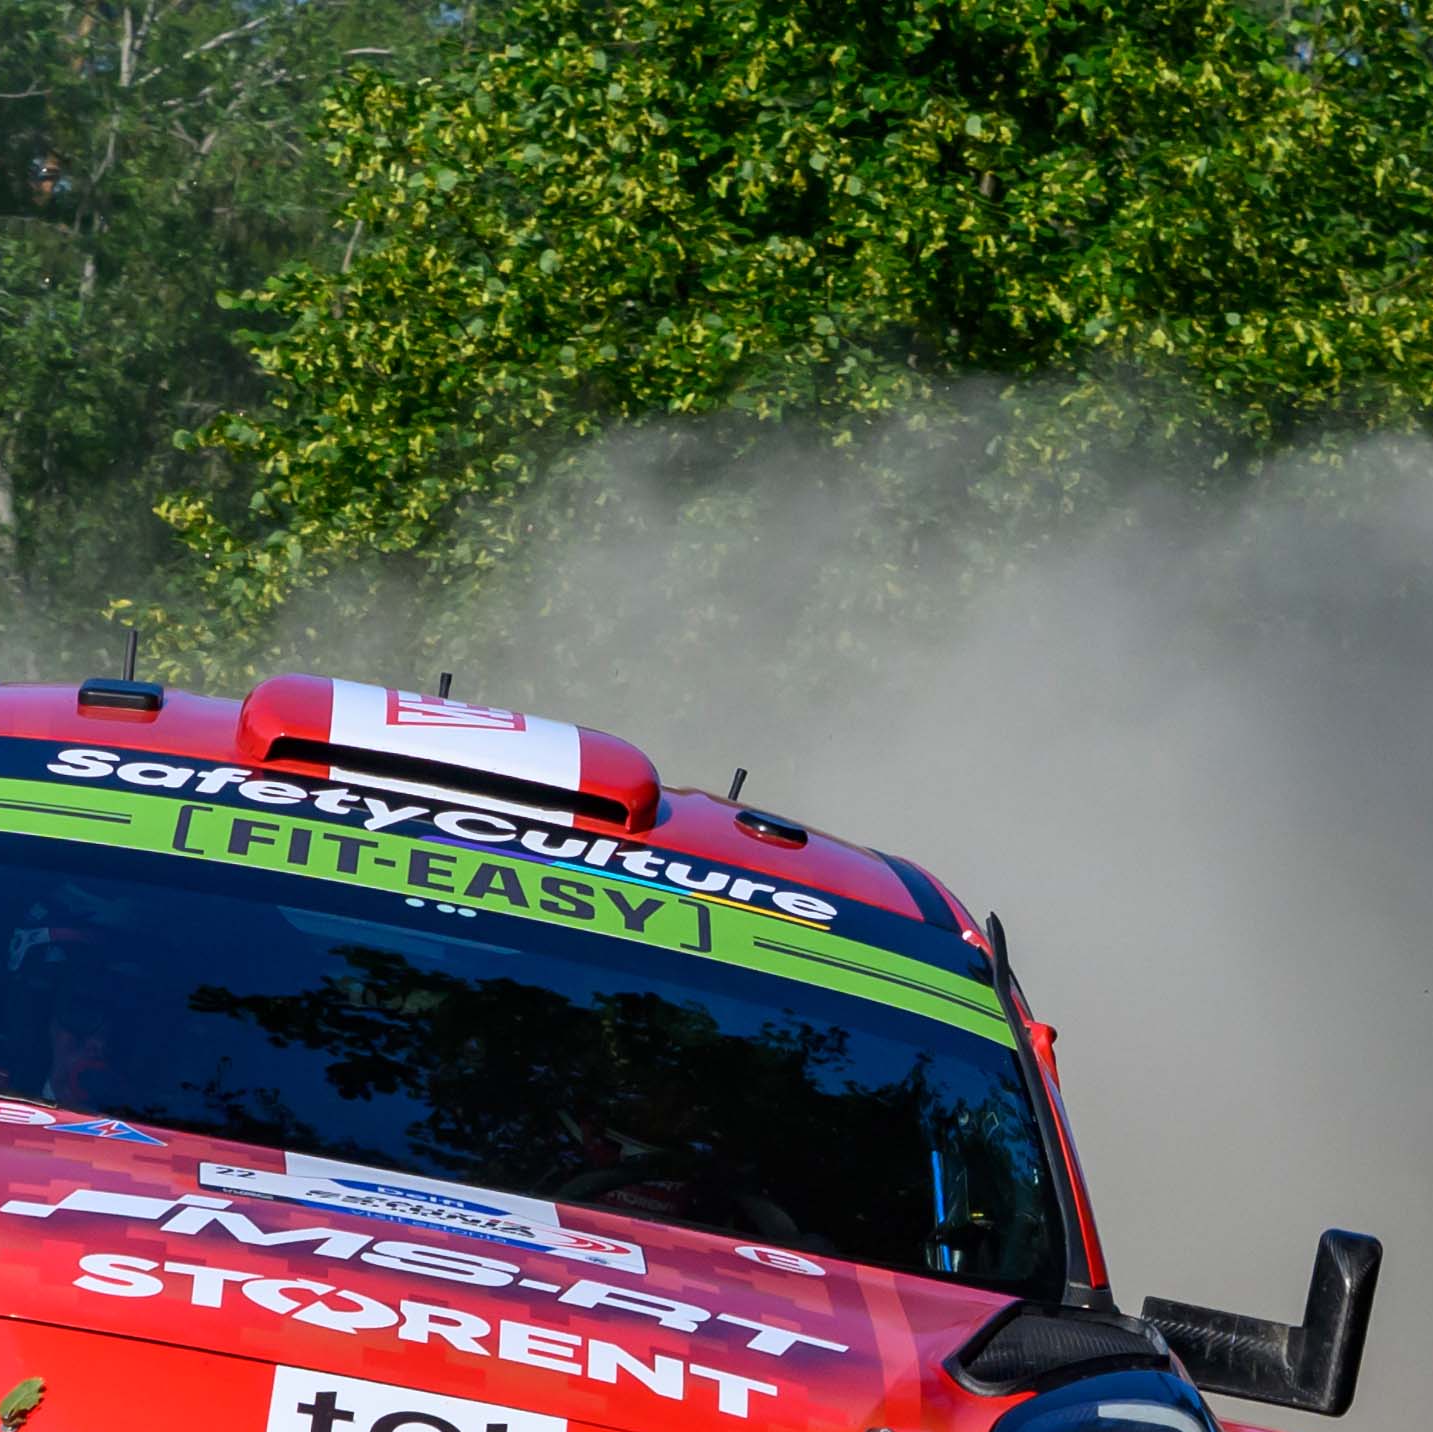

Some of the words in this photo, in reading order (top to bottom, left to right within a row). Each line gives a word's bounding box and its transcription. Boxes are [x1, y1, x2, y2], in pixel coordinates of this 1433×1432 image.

[46, 748, 839, 921] SafetyCulture
[215, 1165, 257, 1180] 22
[376, 1186, 465, 1209] Delfi
[72, 1251, 779, 1420] STORENT
[160, 1192, 850, 1358] MS-RT
